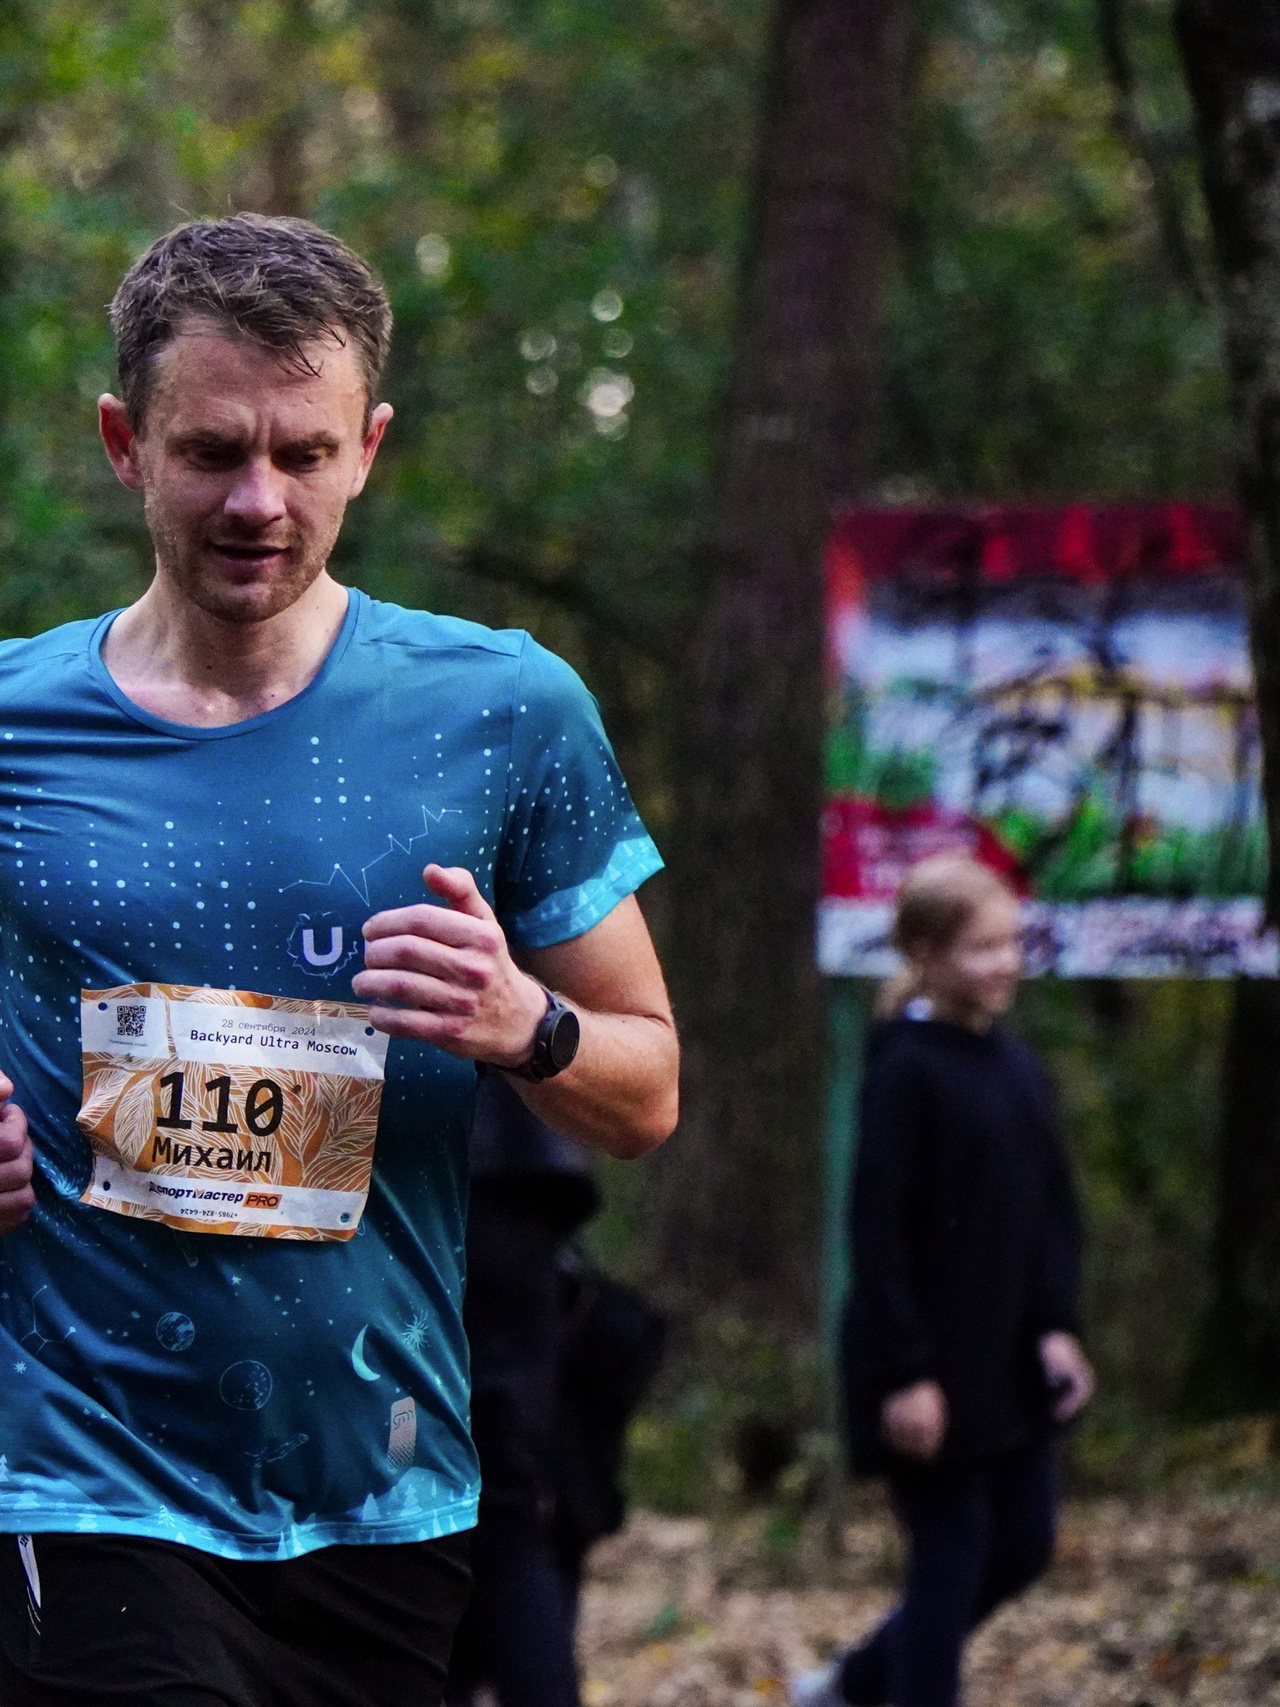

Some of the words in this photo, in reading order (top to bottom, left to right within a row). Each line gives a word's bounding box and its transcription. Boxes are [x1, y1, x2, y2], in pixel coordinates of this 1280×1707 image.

[221, 1018, 234, 1028] 28
[238, 1022, 286, 1034] сентября
[291, 1026, 316, 1036] 2024
[190, 1029, 253, 1046] Backyard
[260, 1035, 299, 1050] Ultra
[307, 1040, 358, 1056] Moscow
[156, 1071, 284, 1137] 110
[151, 1135, 272, 1173] Михаил
[246, 1194, 279, 1207] PRO
